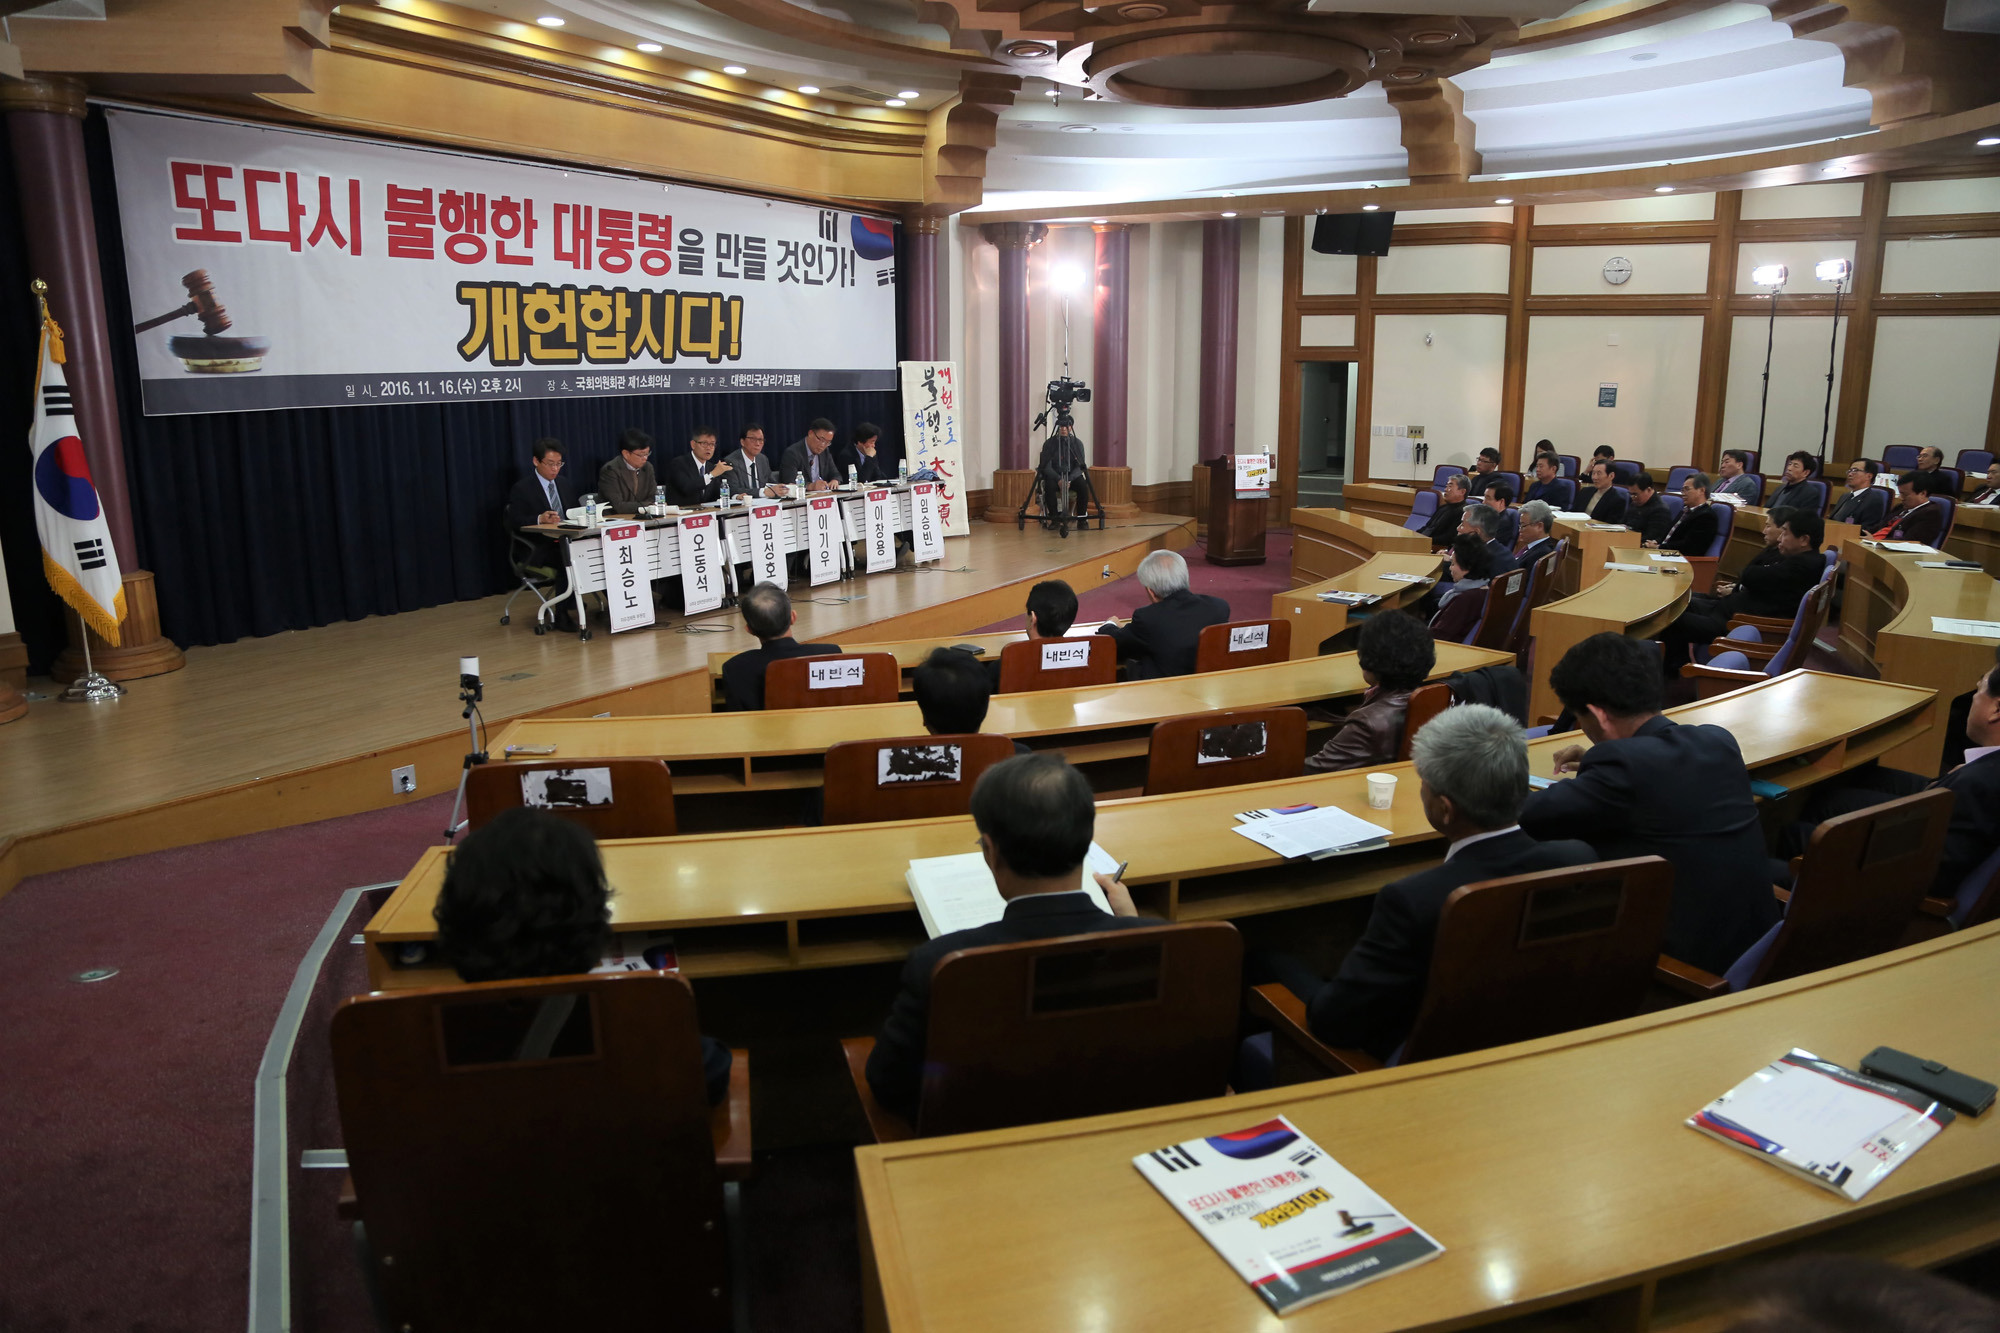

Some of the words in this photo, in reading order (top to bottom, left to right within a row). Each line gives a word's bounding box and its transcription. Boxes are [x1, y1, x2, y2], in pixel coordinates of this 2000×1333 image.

[171, 160, 363, 257] 또다시
[384, 184, 538, 266] 불행한
[553, 202, 705, 277] 대통령을
[716, 232, 767, 281] 만들
[777, 239, 855, 288] 것인가!
[457, 282, 743, 366] 개헌합시다!
[380, 380, 414, 396] 2016.
[417, 380, 435, 396] 11.
[439, 377, 477, 395] 16.(수)
[480, 377, 502, 394] 오후
[505, 377, 522, 394] 2시
[575, 375, 626, 391] 국회의원회관
[628, 374, 671, 388] 제1소회의실
[731, 373, 801, 388] 대한민국살리기포럼
[617, 529, 630, 538] 토론
[691, 518, 704, 527] 토론
[818, 513, 830, 567] 이기우
[874, 505, 885, 557] 이창용
[920, 498, 933, 546] 임승빈
[619, 544, 639, 609] 최승노
[693, 533, 709, 593] 오동석
[762, 523, 776, 579] 김성호
[1046, 648, 1084, 663] 내빈석
[1188, 1190, 1230, 1212] 또다시
